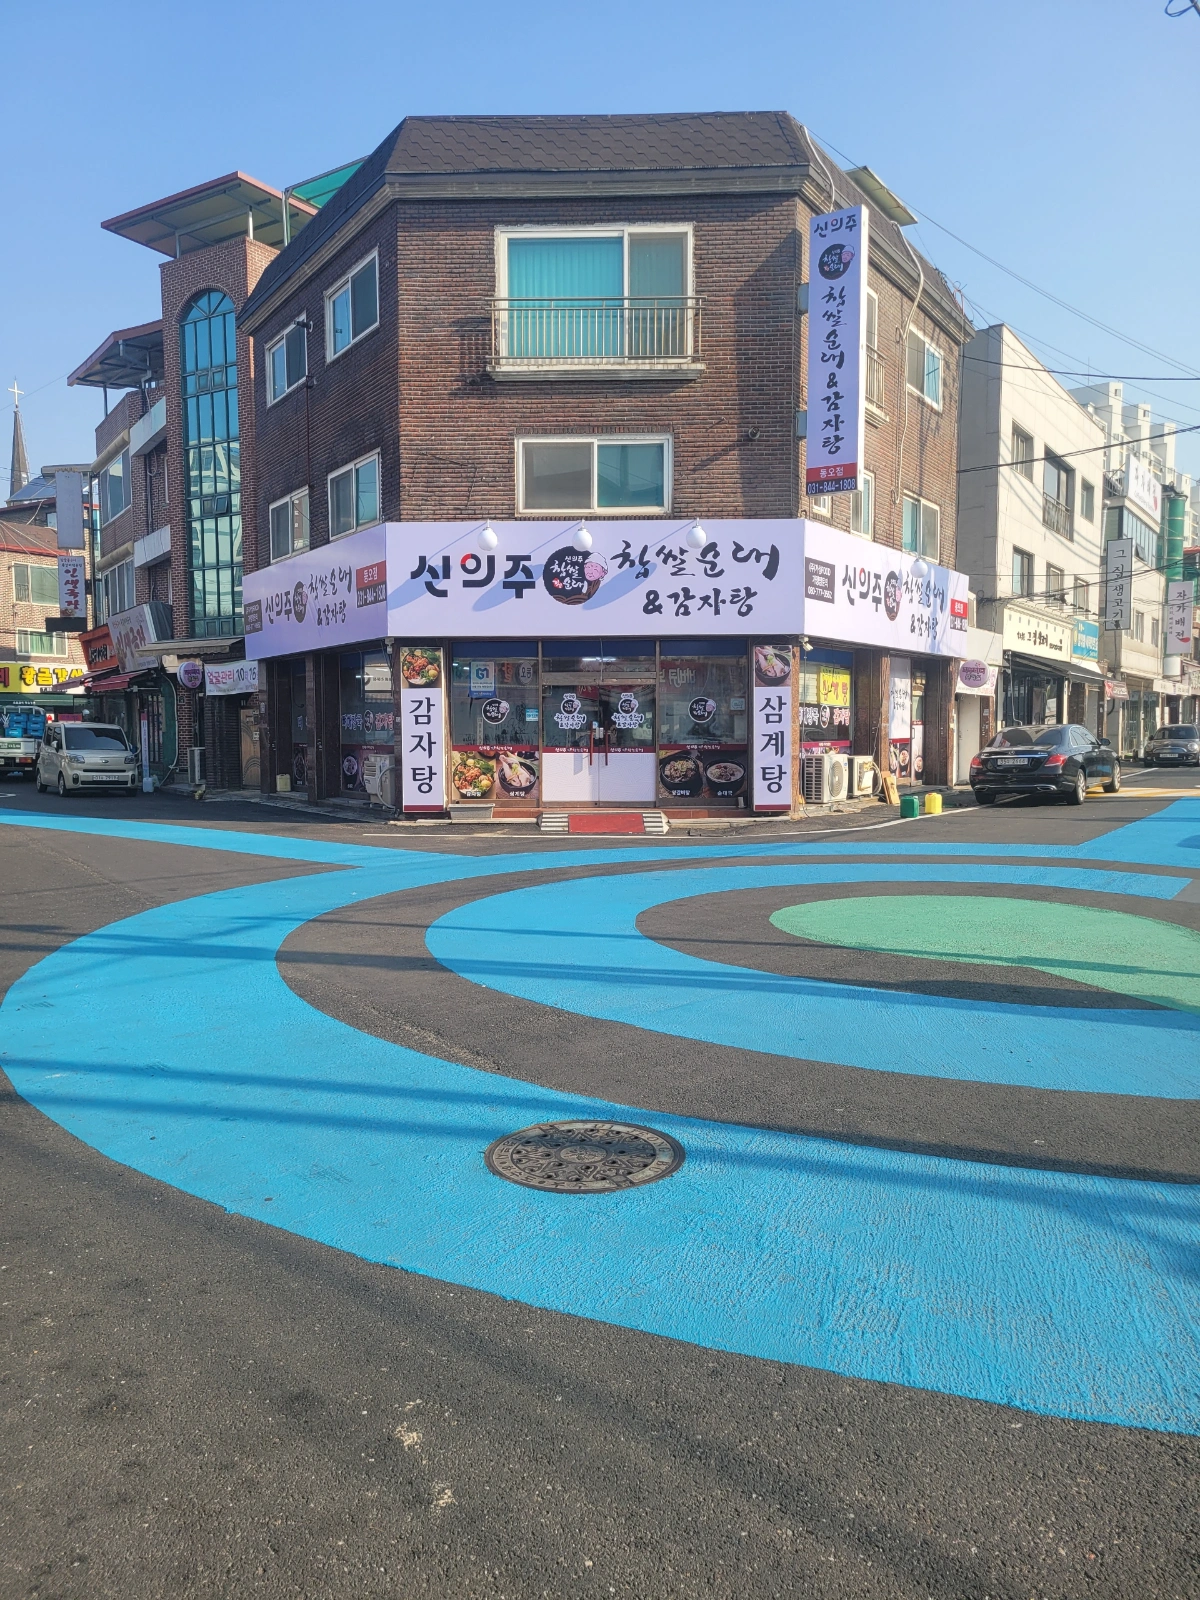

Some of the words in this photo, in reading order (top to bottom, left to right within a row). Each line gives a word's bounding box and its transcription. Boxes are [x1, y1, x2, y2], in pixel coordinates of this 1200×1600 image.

[814, 214, 857, 238] 신의주
[819, 467, 844, 478] 동오점
[807, 479, 856, 494] 031-844-1808
[564, 555, 583, 563] 신의주
[363, 566, 378, 583] 동오점
[410, 553, 536, 599] 신의주
[610, 540, 780, 581] 찹쌀순대
[550, 560, 582, 578] 찹쌀
[265, 590, 293, 624] 신의주
[307, 565, 353, 601] 찹쌀순대
[563, 577, 588, 594] 순대
[842, 565, 882, 612] 신의주
[207, 669, 235, 685] 얼굴관리
[833, 707, 850, 726] 감자탕
[409, 696, 438, 794] 감자탕
[759, 695, 788, 794] 삼계탕
